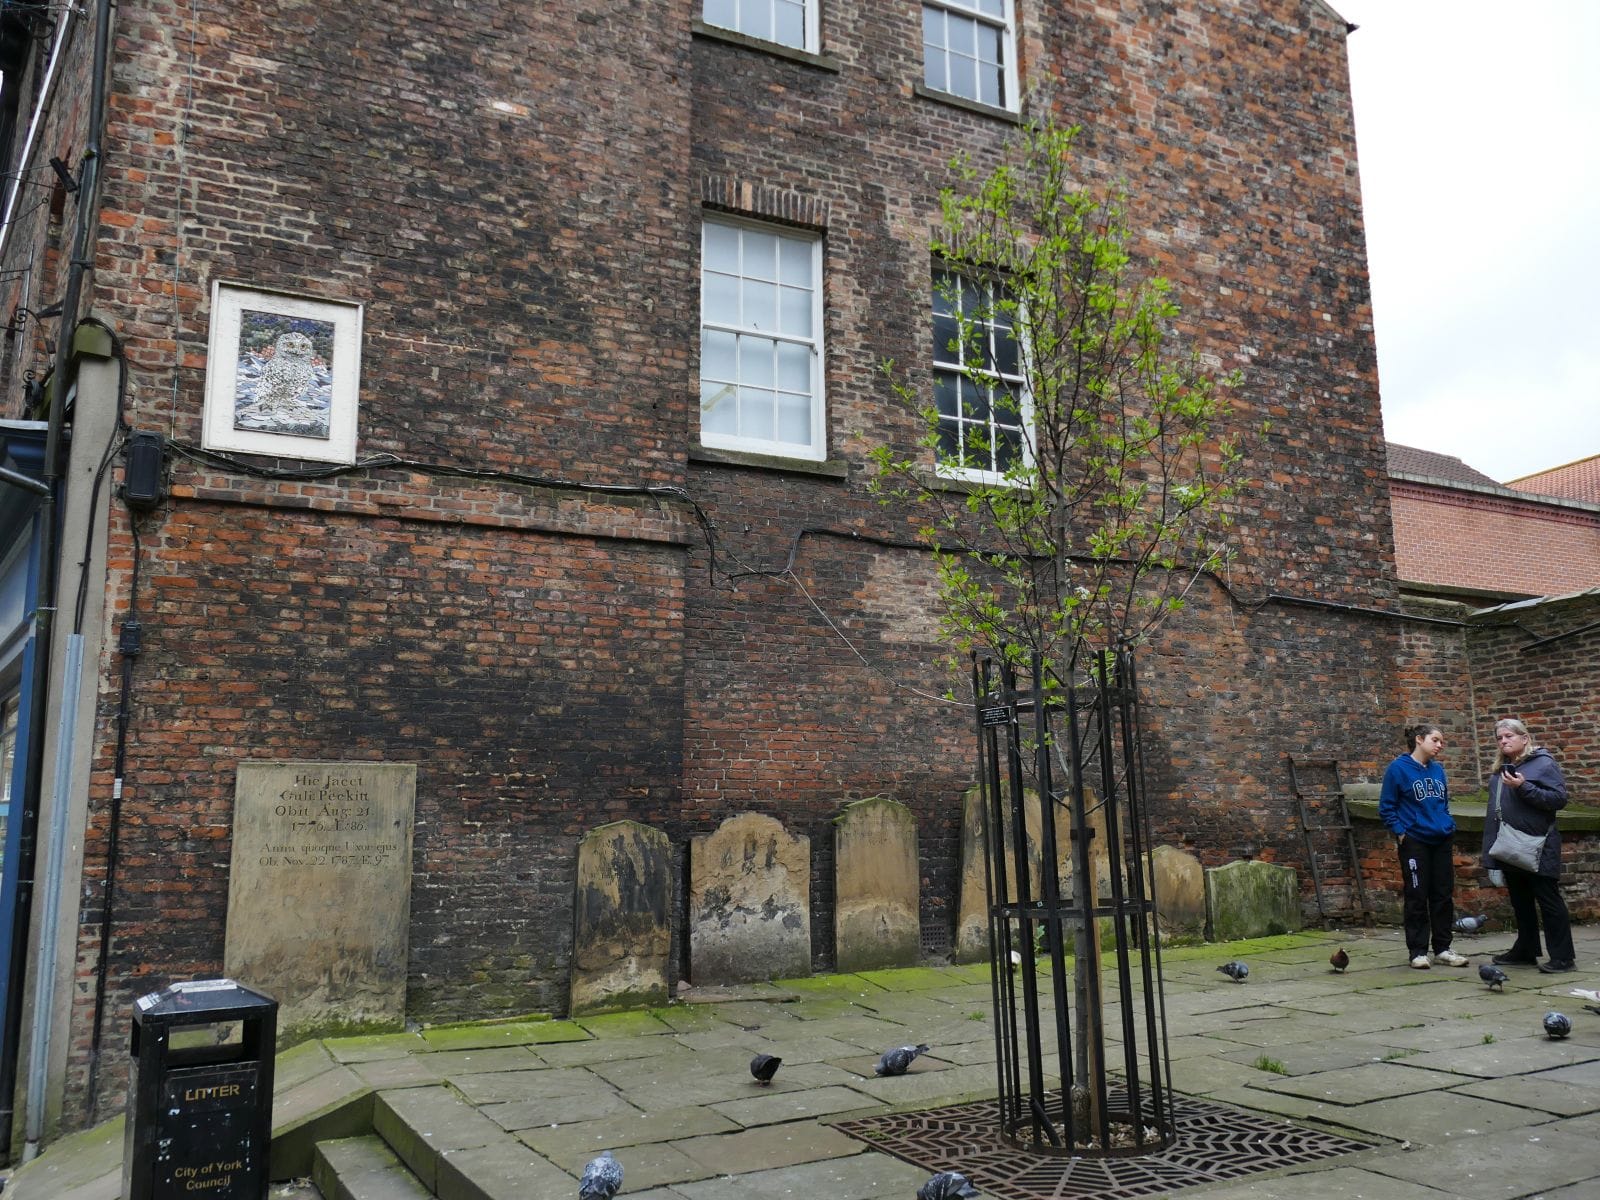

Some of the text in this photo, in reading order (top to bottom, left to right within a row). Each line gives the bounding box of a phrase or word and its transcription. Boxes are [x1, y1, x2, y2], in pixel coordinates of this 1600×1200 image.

[1412, 777, 1445, 802] GAP
[275, 805, 309, 816] Obit
[185, 1084, 241, 1102] LITTER
[174, 1160, 242, 1179] City of York
[186, 1175, 231, 1191] Council
